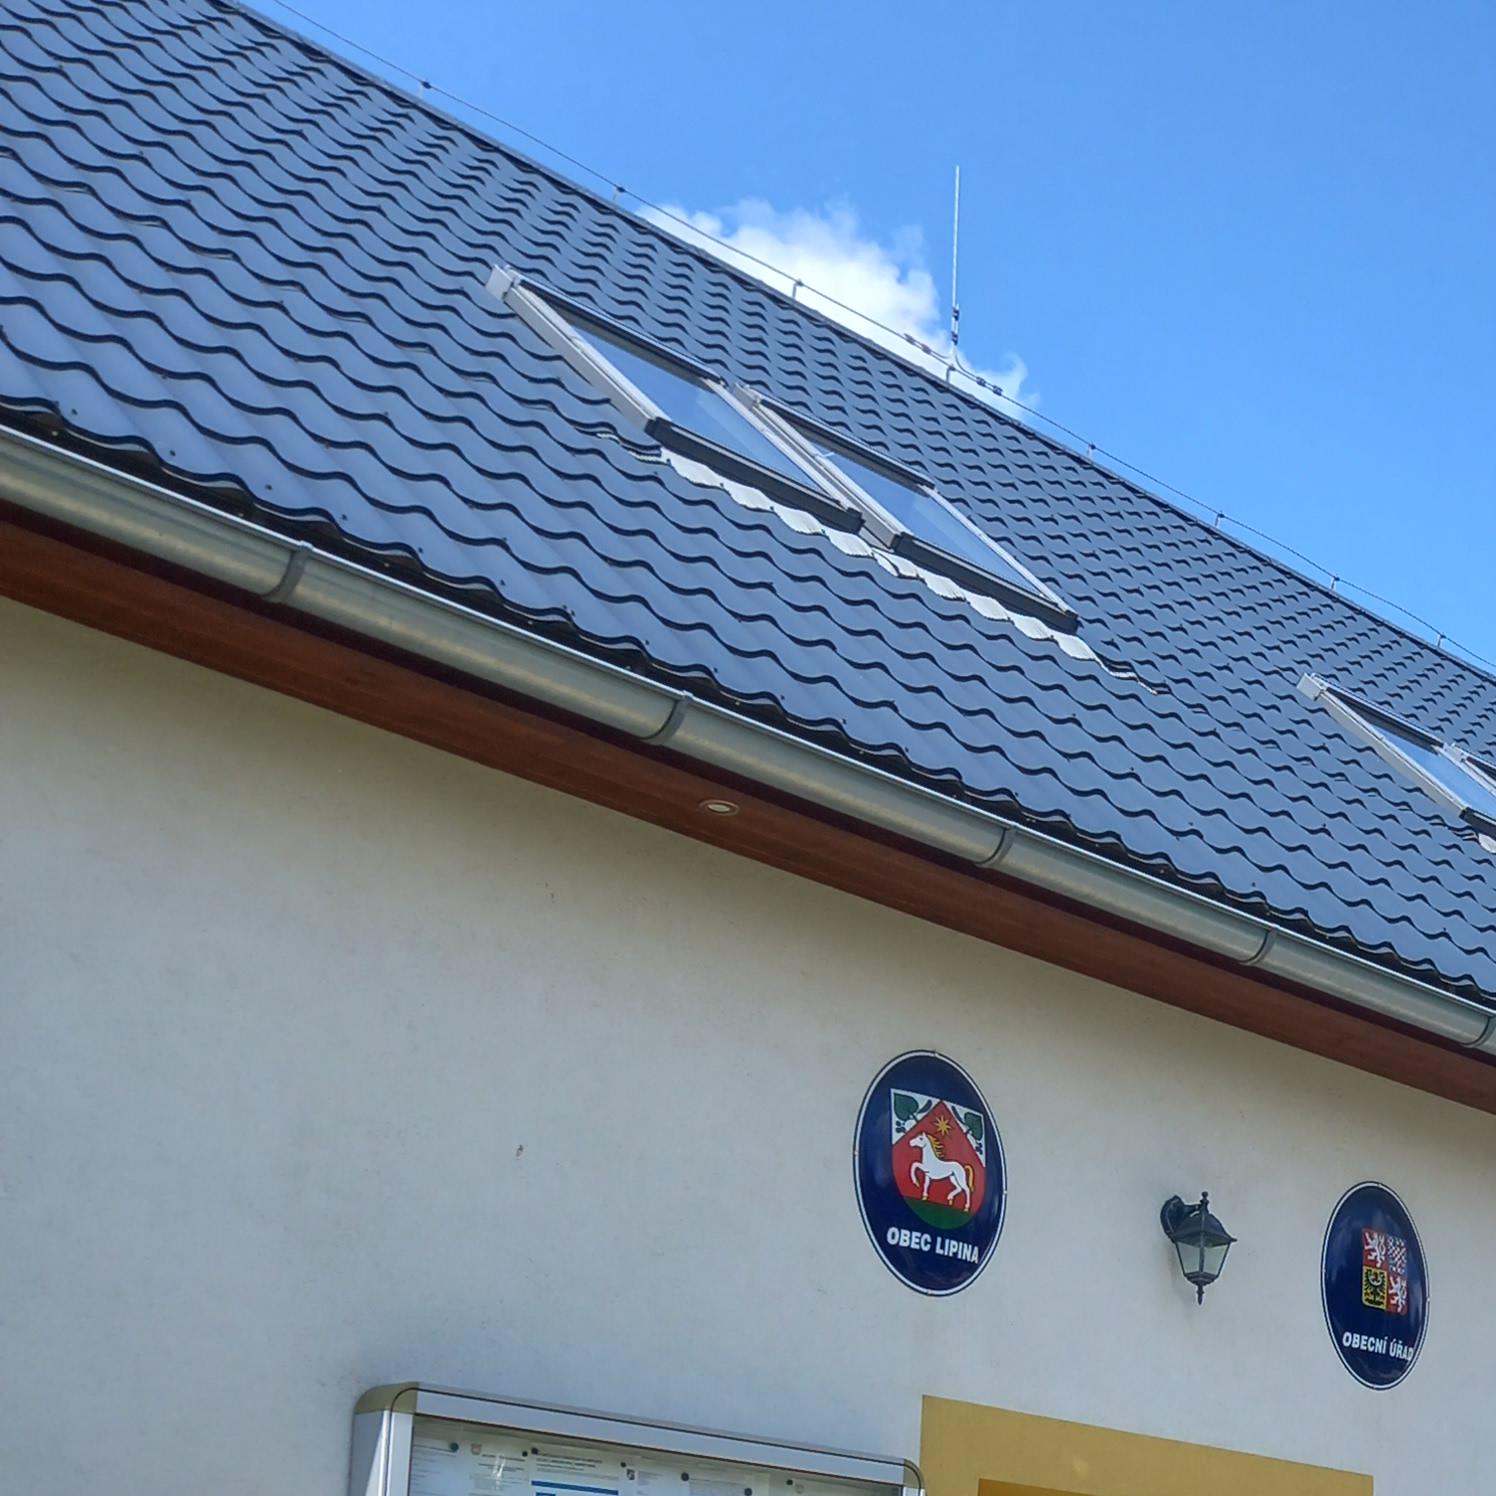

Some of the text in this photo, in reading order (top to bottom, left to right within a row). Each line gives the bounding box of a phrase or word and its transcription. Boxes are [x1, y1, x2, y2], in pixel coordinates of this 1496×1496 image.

[886, 1227, 979, 1264] OBEC LIPINA
[1342, 1331, 1415, 1361] OBECNÍ ÚŘAD
